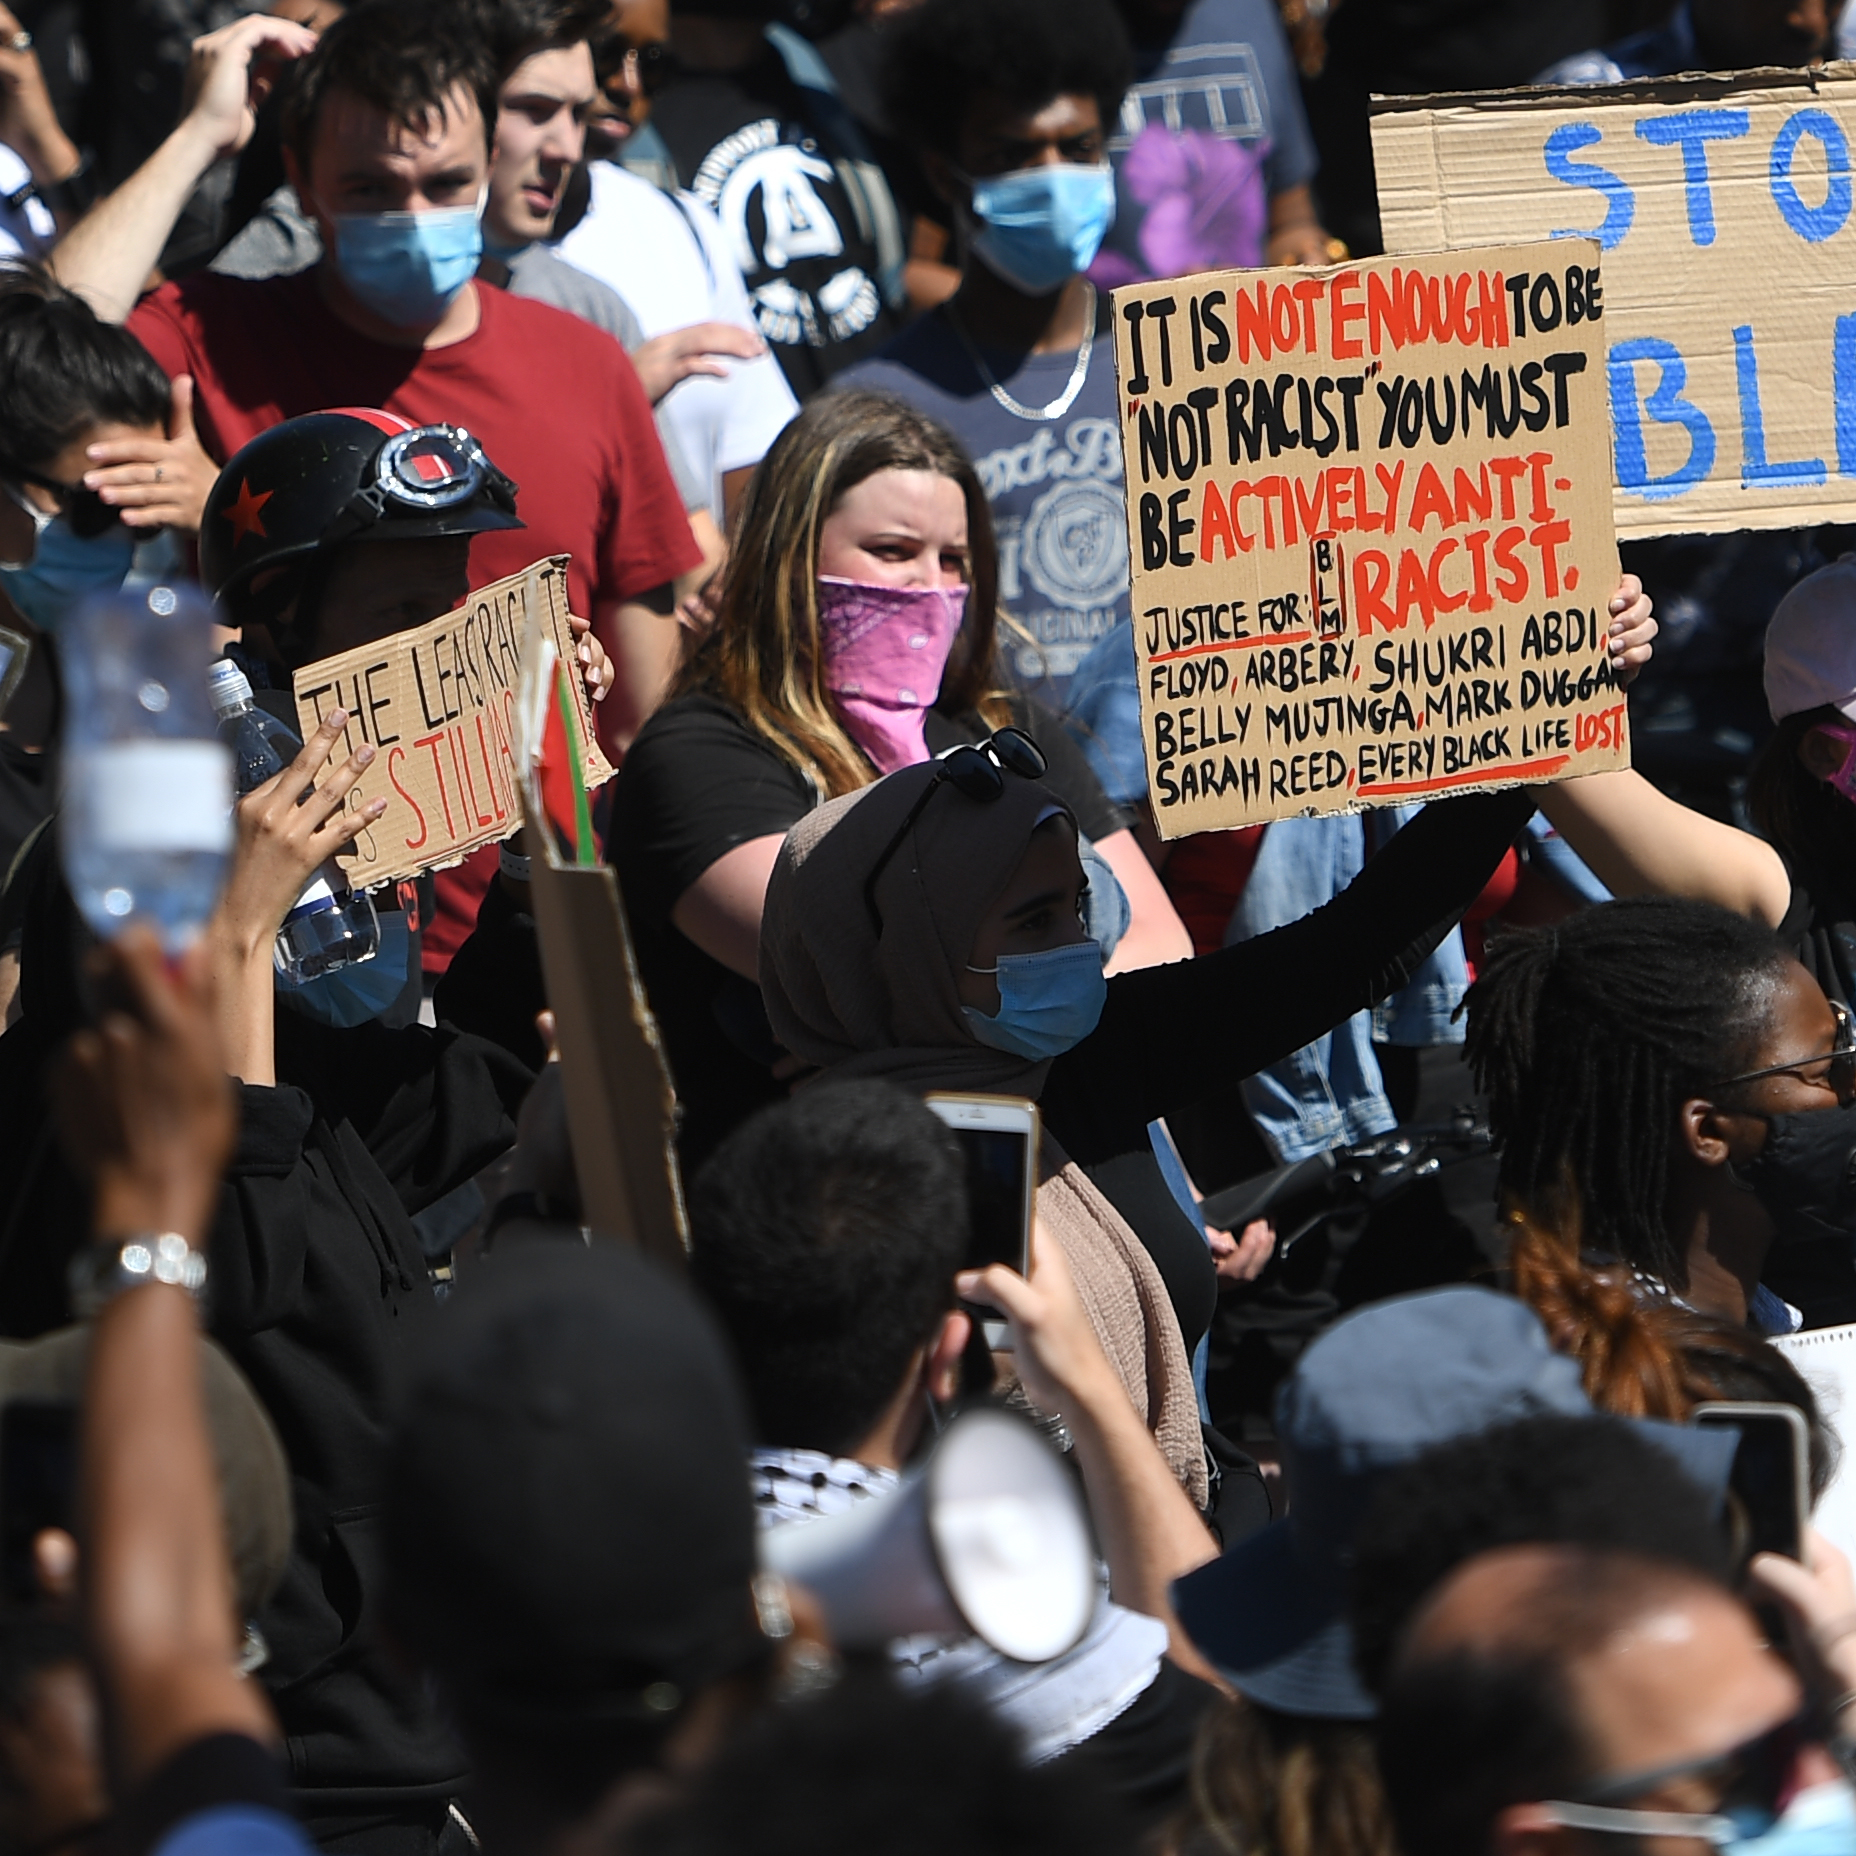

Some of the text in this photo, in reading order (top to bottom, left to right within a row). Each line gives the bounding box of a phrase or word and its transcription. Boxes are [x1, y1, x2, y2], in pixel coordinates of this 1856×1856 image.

[1123, 265, 1603, 395] IT IS NOT ENOUGH TO BE
[1127, 386, 1219, 483] "NOT
[1225, 361, 1383, 466] RACIST"
[1376, 373, 1456, 449] YOU
[1460, 351, 1587, 443] MUST
[1140, 452, 1573, 571] BE ACTIVELY ANTI-
[1143, 600, 1250, 655] JUSTICE
[1352, 519, 1580, 637] RACIST.
[299, 662, 401, 766] THE
[477, 568, 562, 694] RACT
[1150, 657, 1239, 701] FLOYD,
[1244, 639, 1361, 693] ARBERY,
[1369, 625, 1507, 694] SHUKRI
[1155, 703, 1251, 762] BELLY
[1265, 690, 1425, 744] MUJINGA,
[1425, 679, 1512, 729] MARK
[387, 715, 506, 849] STILL
[1155, 756, 1261, 808] SARAH
[1269, 750, 1357, 804] REED,
[1358, 737, 1435, 785] EVERY
[1444, 727, 1510, 774] BLACK
[1521, 719, 1572, 758] LIFE
